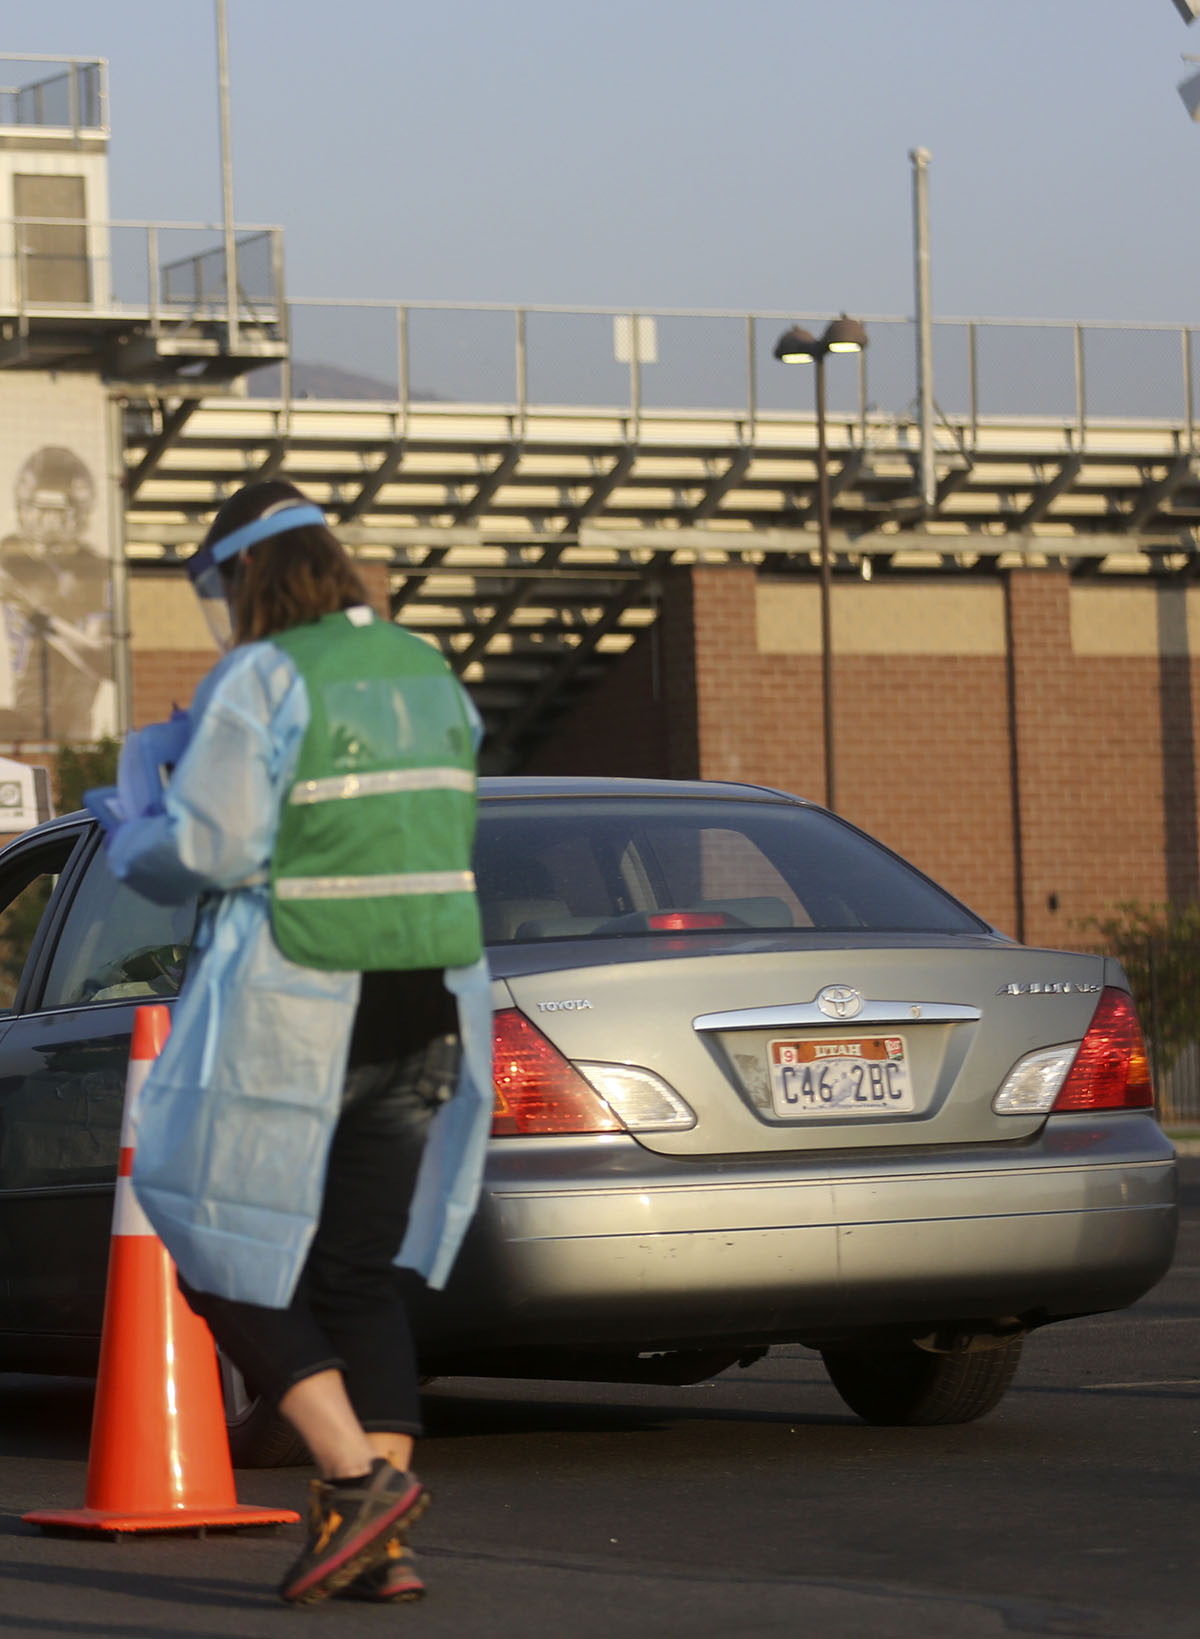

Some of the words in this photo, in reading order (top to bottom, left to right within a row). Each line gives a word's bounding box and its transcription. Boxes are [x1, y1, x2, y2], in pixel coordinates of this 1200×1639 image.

[536, 999, 593, 1012] TOYOTA
[783, 1050, 794, 1063] 9
[814, 1043, 862, 1058] UTAH
[782, 1066, 833, 1104] C46
[851, 1062, 902, 1102] 2BC
